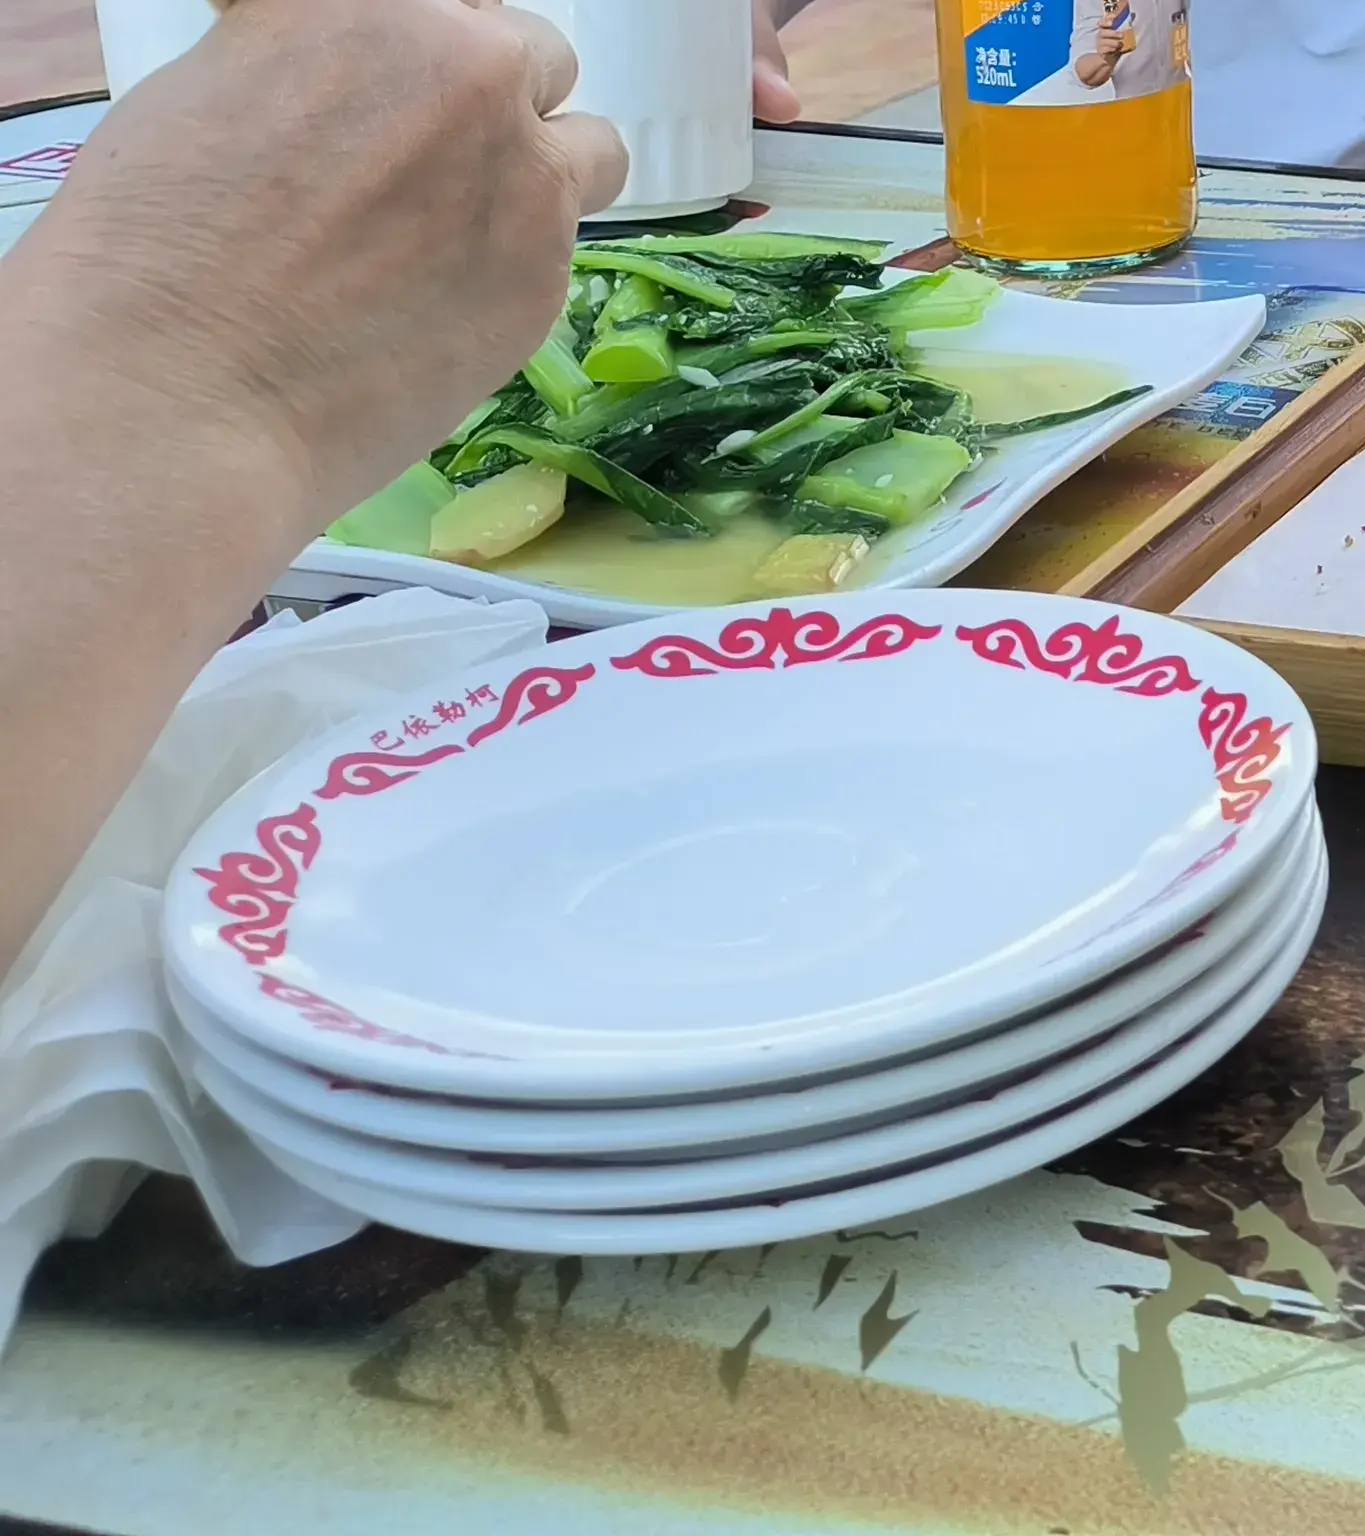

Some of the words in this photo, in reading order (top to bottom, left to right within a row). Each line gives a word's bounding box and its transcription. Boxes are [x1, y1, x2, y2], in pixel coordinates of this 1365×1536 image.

[976, 66, 1017, 87] 520mL
[370, 683, 499, 751] 巴依勒柯
